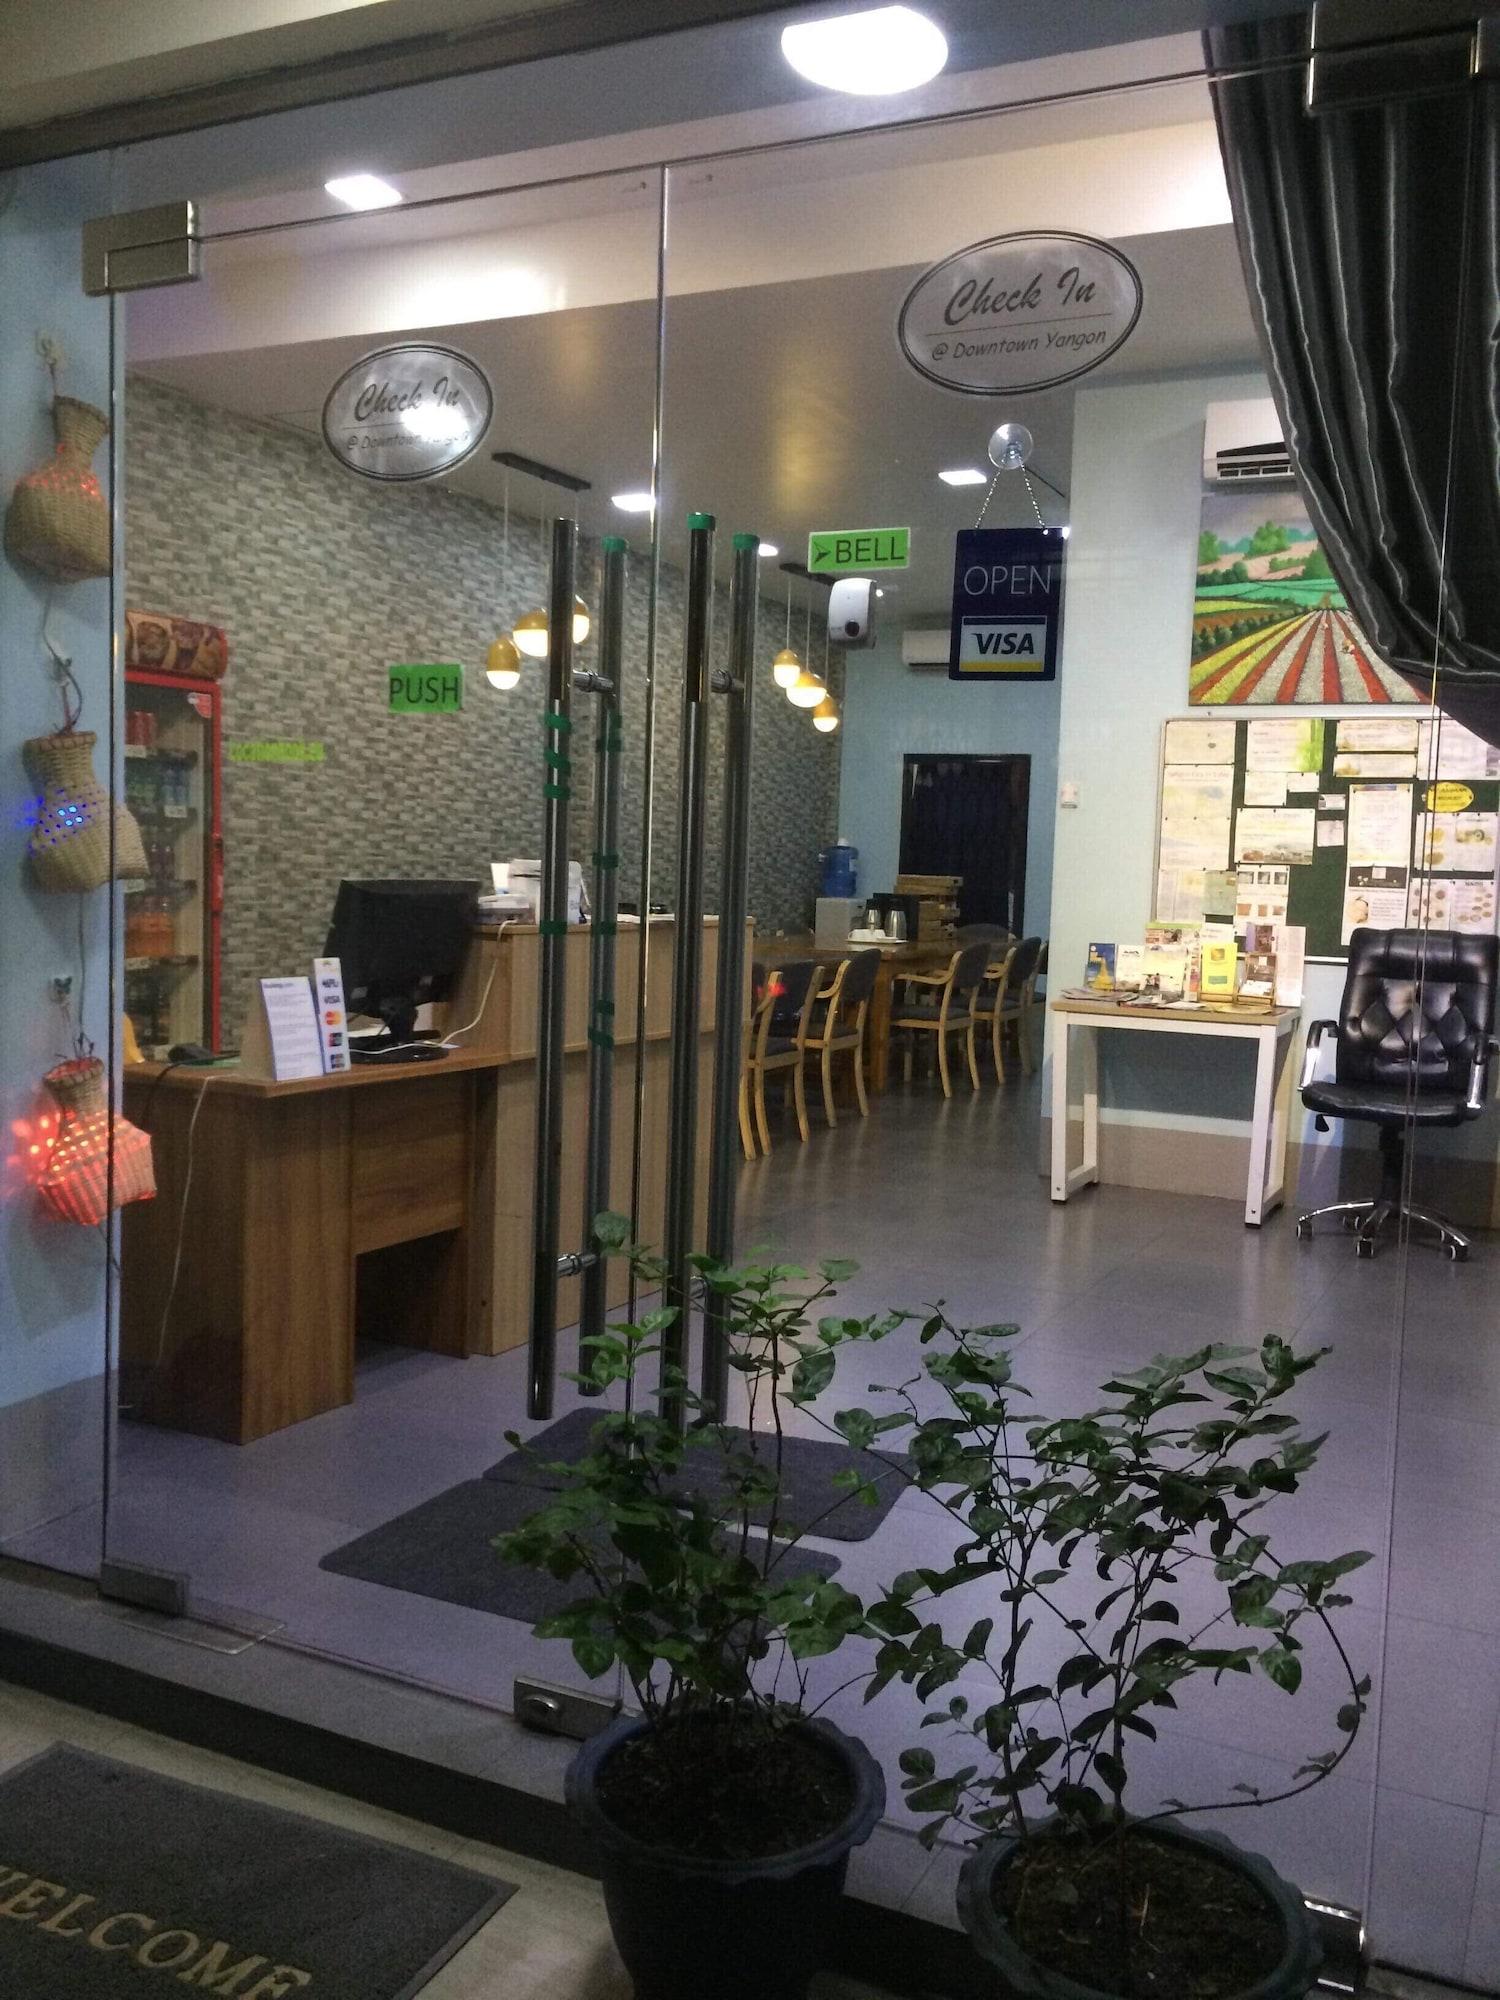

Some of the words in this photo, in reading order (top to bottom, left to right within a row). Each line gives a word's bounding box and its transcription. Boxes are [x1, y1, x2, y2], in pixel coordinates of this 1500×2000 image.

[944, 273, 1043, 325] Check
[1057, 266, 1096, 305] In
[932, 343, 948, 361] @
[953, 338, 1038, 359] Downtown
[1045, 330, 1106, 352] Yangon
[355, 380, 422, 421] Check
[433, 376, 460, 407] In
[835, 536, 905, 564] BELL
[963, 565, 1051, 595] OPEN
[973, 632, 1035, 655] VISA
[390, 676, 459, 705] PUSH
